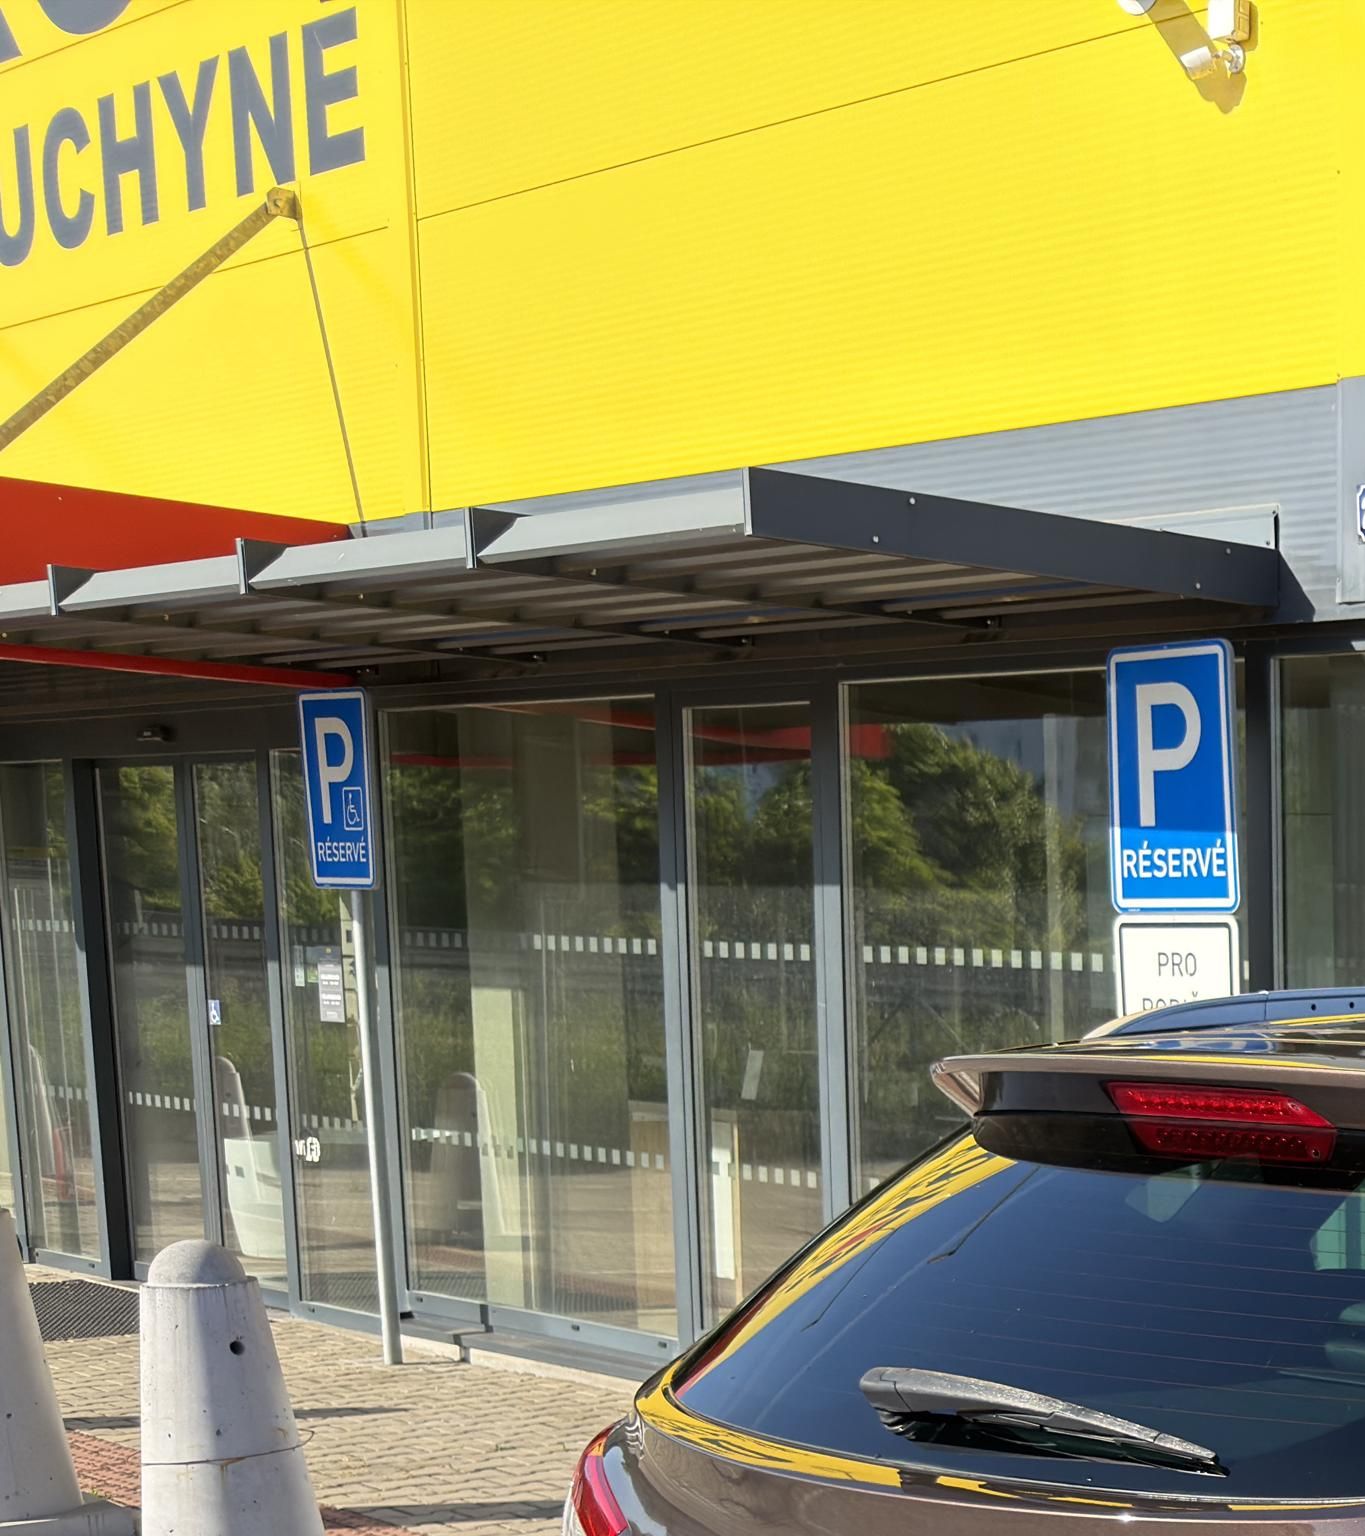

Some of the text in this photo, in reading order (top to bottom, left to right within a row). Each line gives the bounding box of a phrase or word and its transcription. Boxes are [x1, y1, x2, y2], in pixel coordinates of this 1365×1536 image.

[314, 716, 354, 824] P
[1135, 681, 1201, 828] P
[317, 835, 367, 863] RÉSERVÉ
[1121, 837, 1227, 879] RÉSERVÉ
[1157, 951, 1197, 978] PRO
